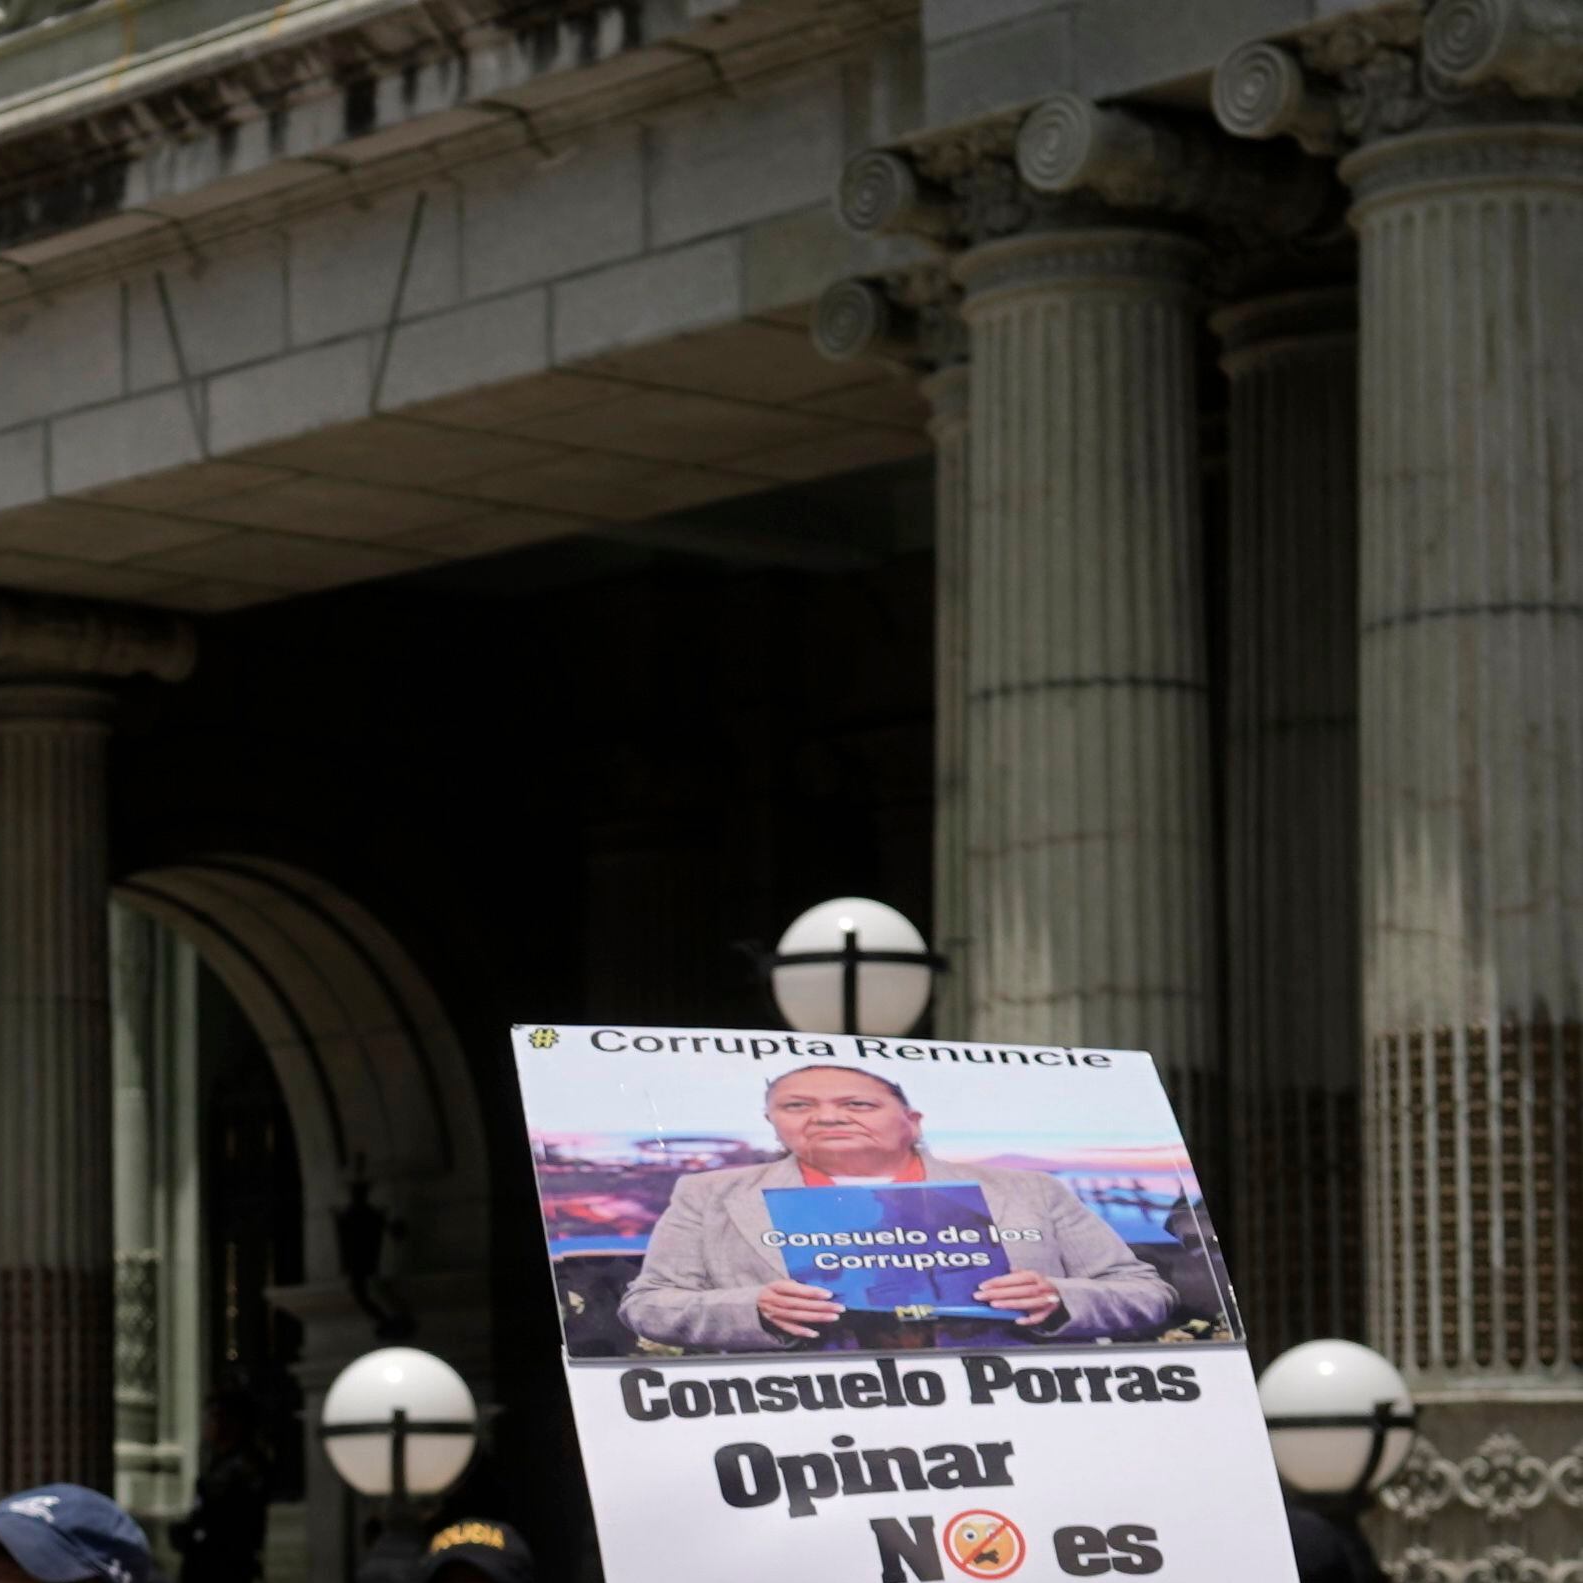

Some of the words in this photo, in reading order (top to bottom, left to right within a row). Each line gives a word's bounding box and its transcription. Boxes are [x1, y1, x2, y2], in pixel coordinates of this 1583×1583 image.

[589, 1028, 838, 1062] Corrupta
[854, 1035, 1114, 1070] Renuncie
[760, 1224, 928, 1249] Consuelo
[938, 1223, 983, 1246] de
[989, 1222, 1044, 1245] los
[813, 1248, 992, 1275] Corruptos
[619, 1359, 947, 1422] Consuelo
[969, 1355, 1201, 1407] Porras
[714, 1434, 1015, 1518] Opinar
[1052, 1522, 1164, 1575] es
